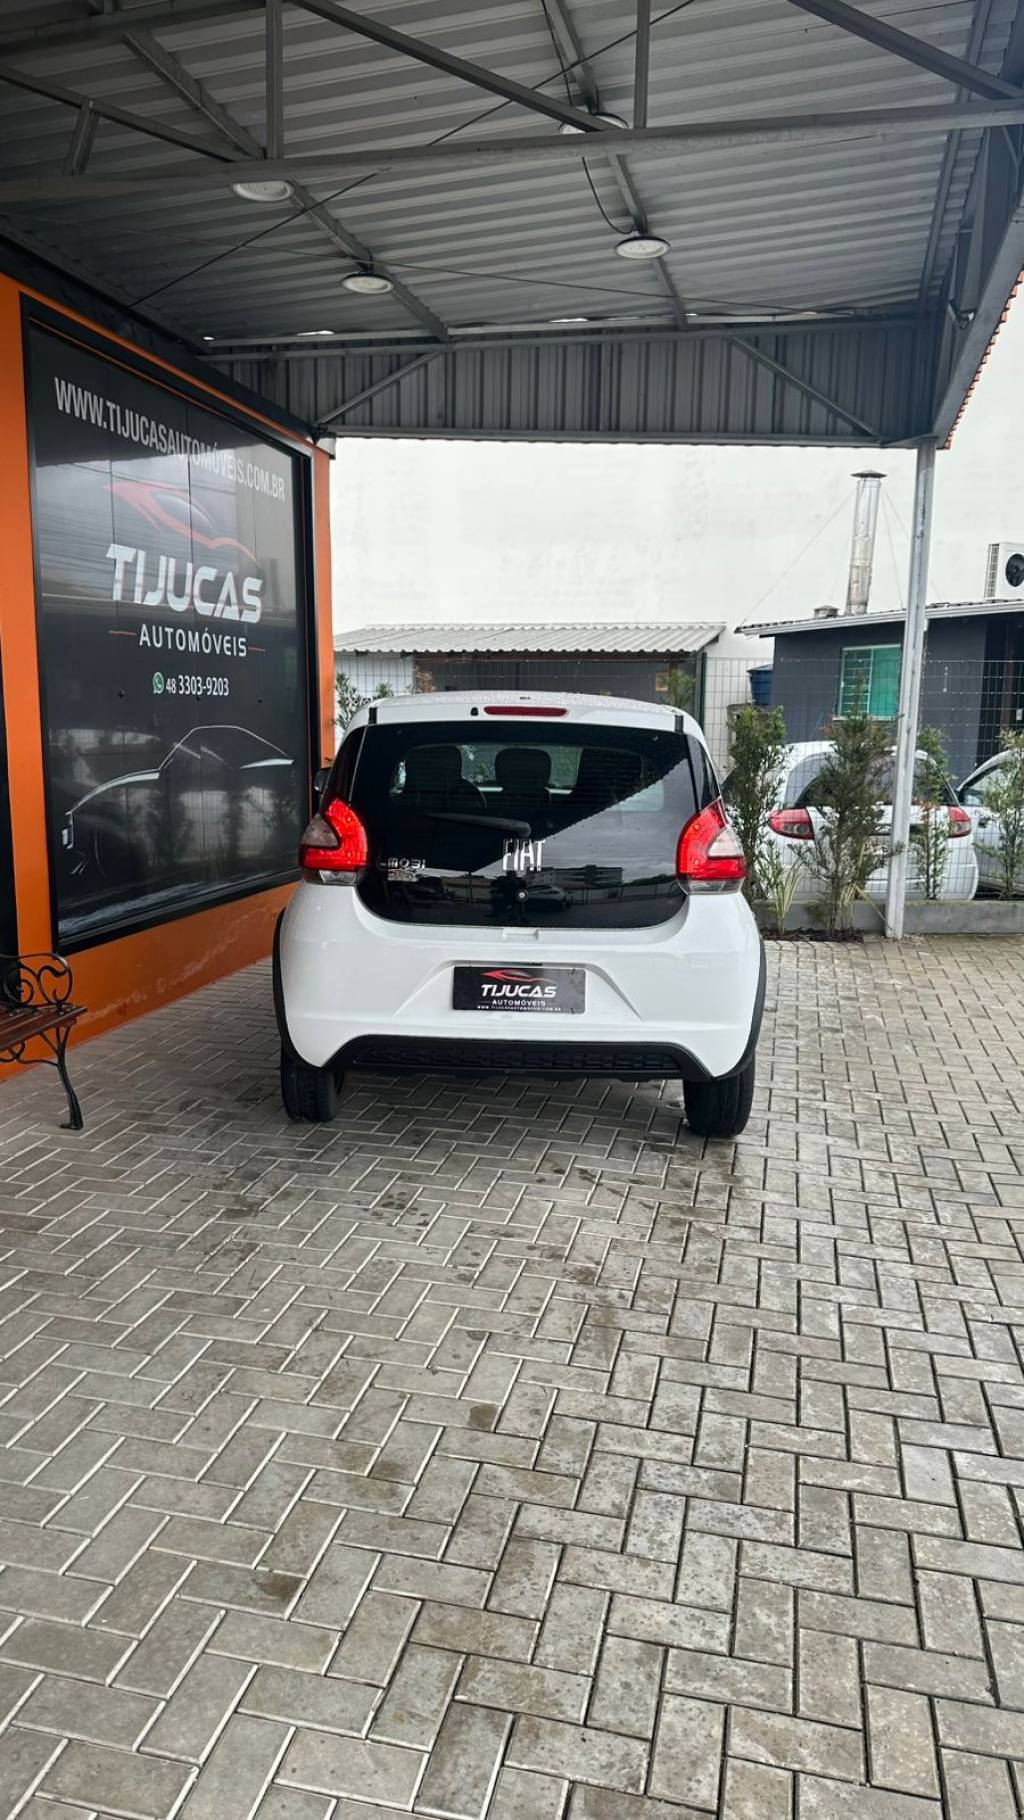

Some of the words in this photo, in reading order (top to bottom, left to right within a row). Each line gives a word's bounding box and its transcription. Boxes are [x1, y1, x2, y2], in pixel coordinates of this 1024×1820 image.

[54, 376, 285, 500] WWW.TIJUCASAUTOMÓVEIS.COM.BR
[106, 543, 263, 624] TIJUCAS
[139, 623, 247, 657] AUTOMÓVEIS
[166, 678, 177, 694] 48
[178, 675, 229, 696] 3303-9203
[503, 838, 546, 871] FIAT
[481, 984, 558, 998] TIJUCAS
